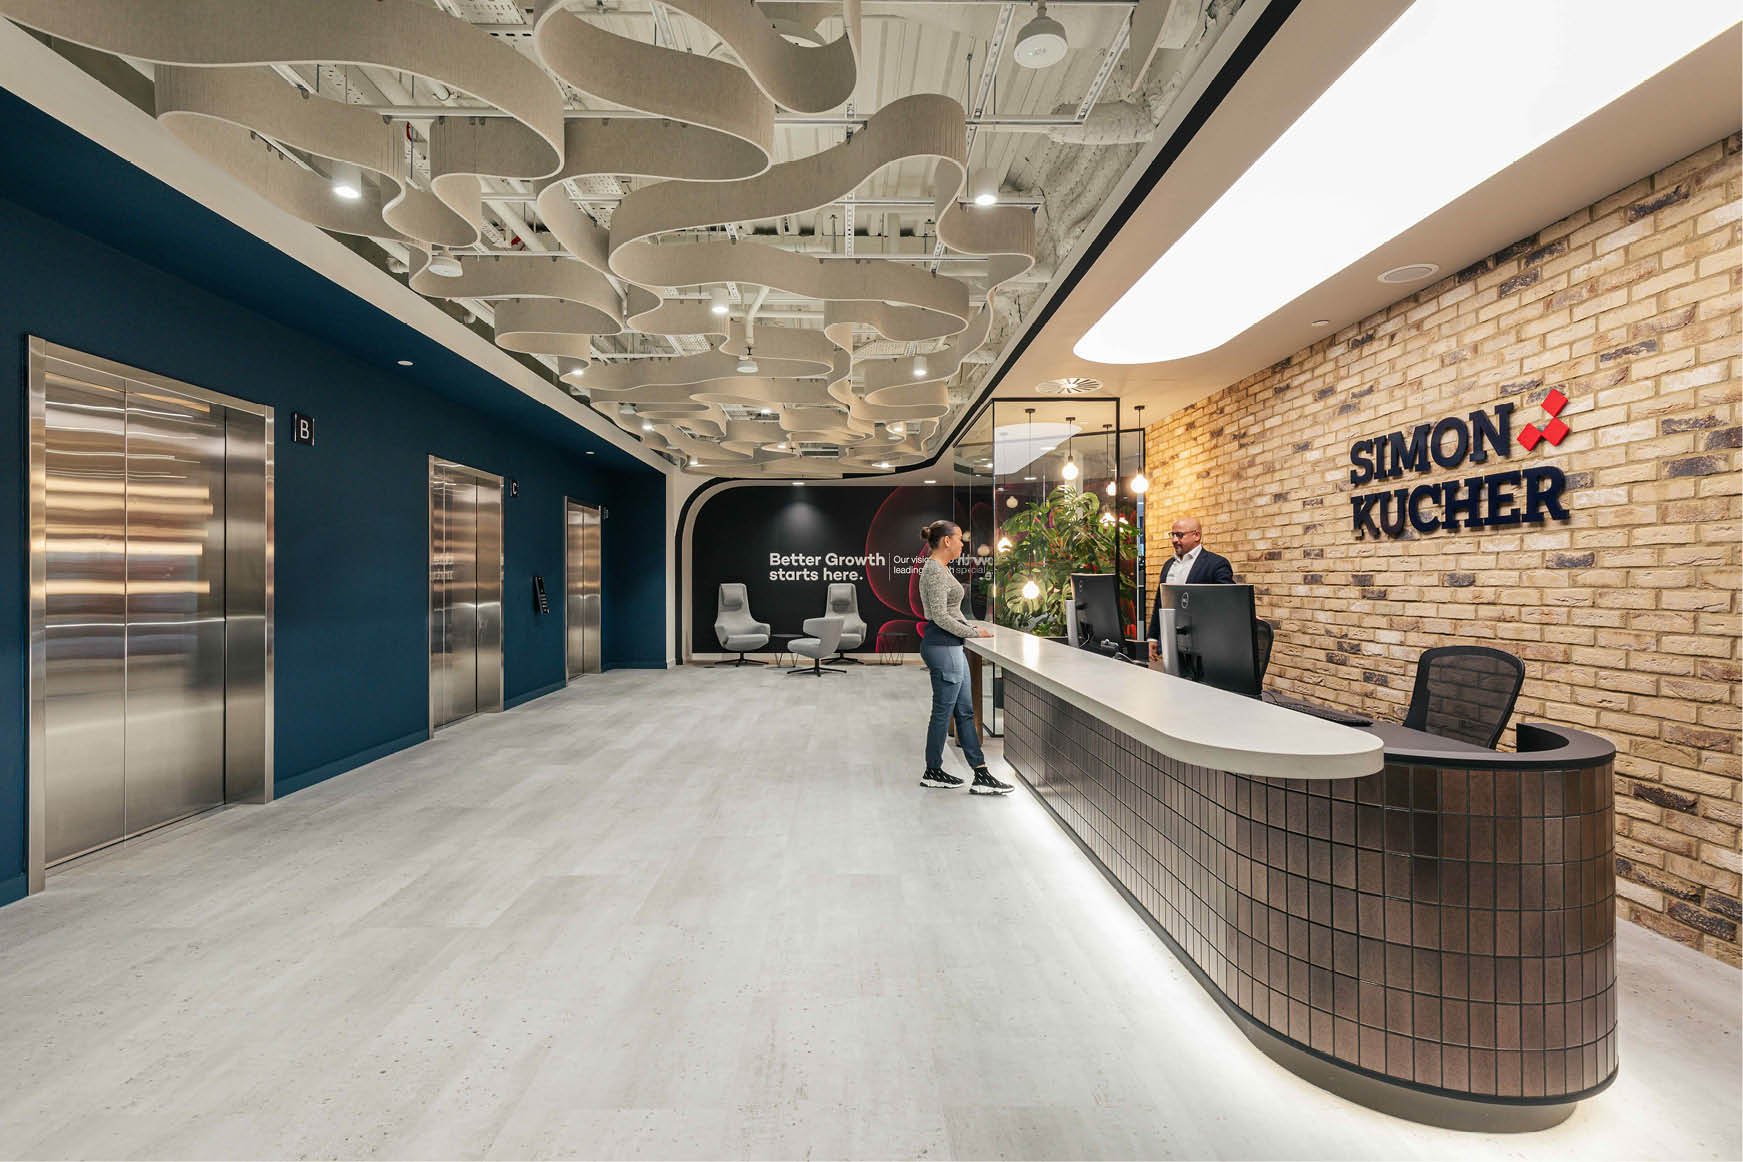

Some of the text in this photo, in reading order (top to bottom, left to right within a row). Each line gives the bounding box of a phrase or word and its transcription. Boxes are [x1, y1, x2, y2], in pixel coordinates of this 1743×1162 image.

[300, 419, 309, 439] B
[1350, 402, 1514, 485] SIMON
[1350, 465, 1570, 539] KUCHER
[769, 552, 886, 566] Better Growth
[893, 555, 910, 564] Our
[769, 567, 864, 581] starts here.
[893, 566, 923, 576] leading
